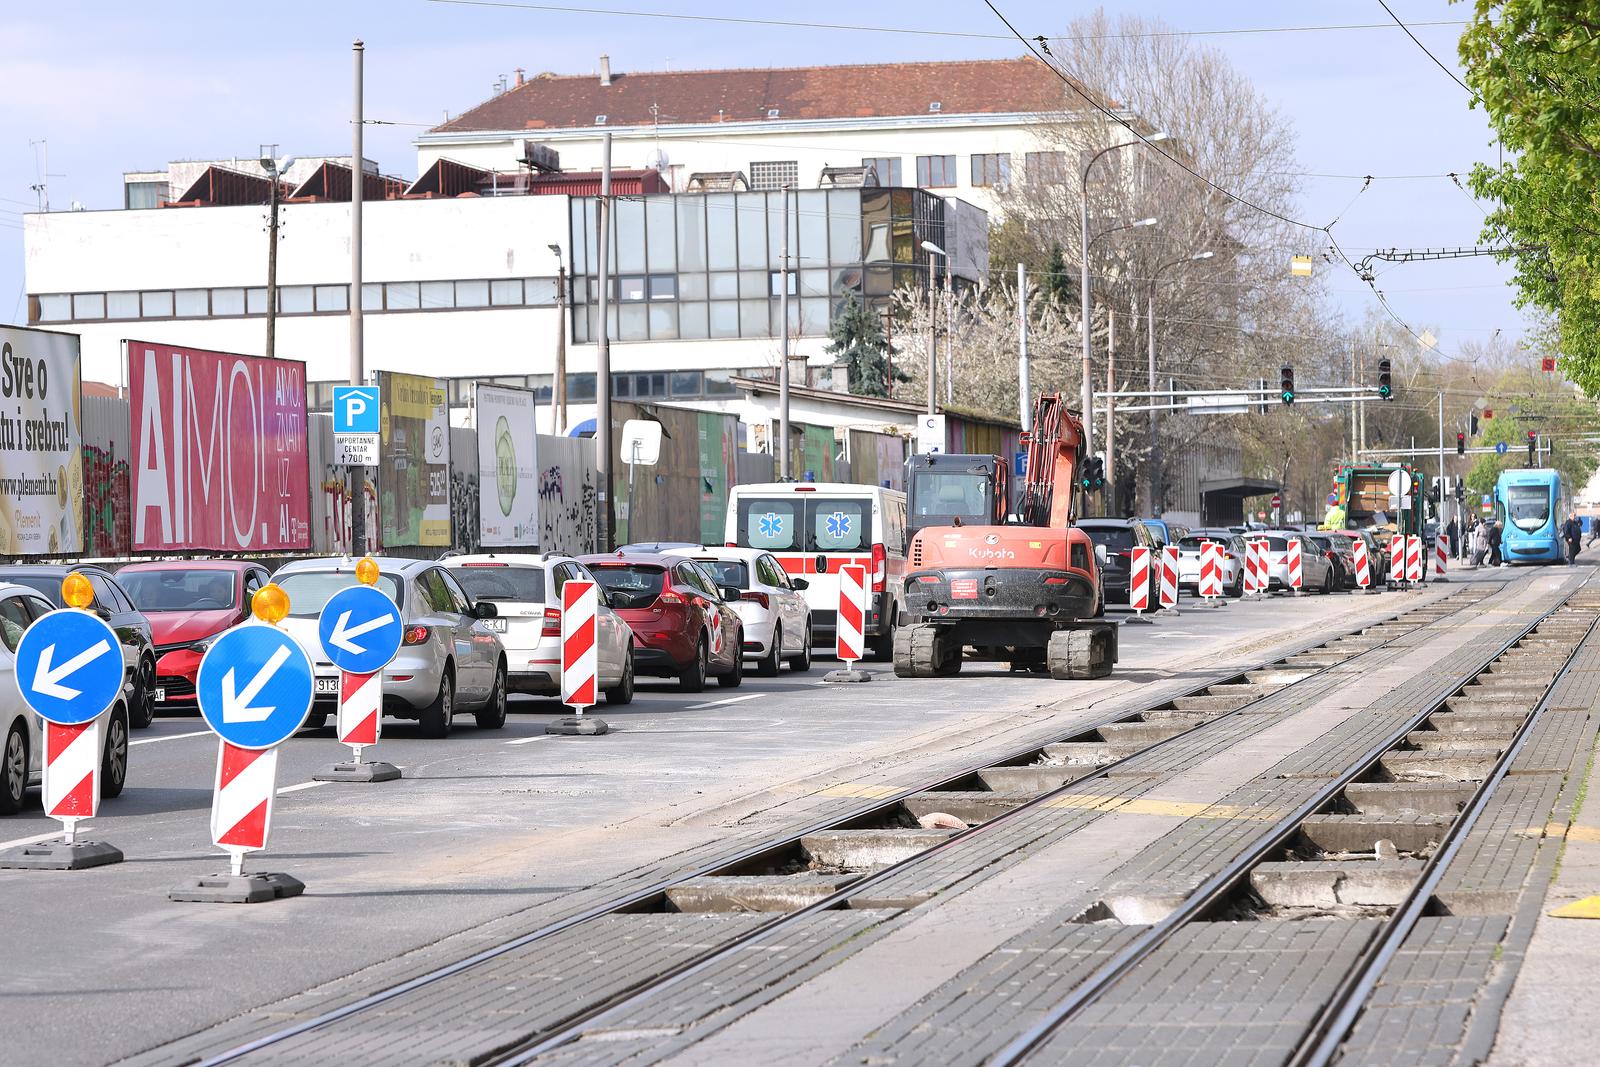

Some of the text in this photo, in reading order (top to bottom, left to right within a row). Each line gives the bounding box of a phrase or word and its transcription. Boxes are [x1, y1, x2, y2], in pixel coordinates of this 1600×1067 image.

[2, 342, 47, 400] Sve o
[275, 366, 300, 408] AIMO!
[0, 406, 69, 452] tu i srebru!
[346, 398, 366, 427] P
[135, 350, 268, 548] AIMO!
[276, 413, 300, 453] ZNATI
[336, 436, 375, 445] IMPORTANNE
[344, 445, 368, 453] CENTAR
[278, 458, 290, 498] UZ
[348, 454, 363, 463] 700
[279, 503, 290, 544] AI
[968, 547, 1015, 559] Kubota
